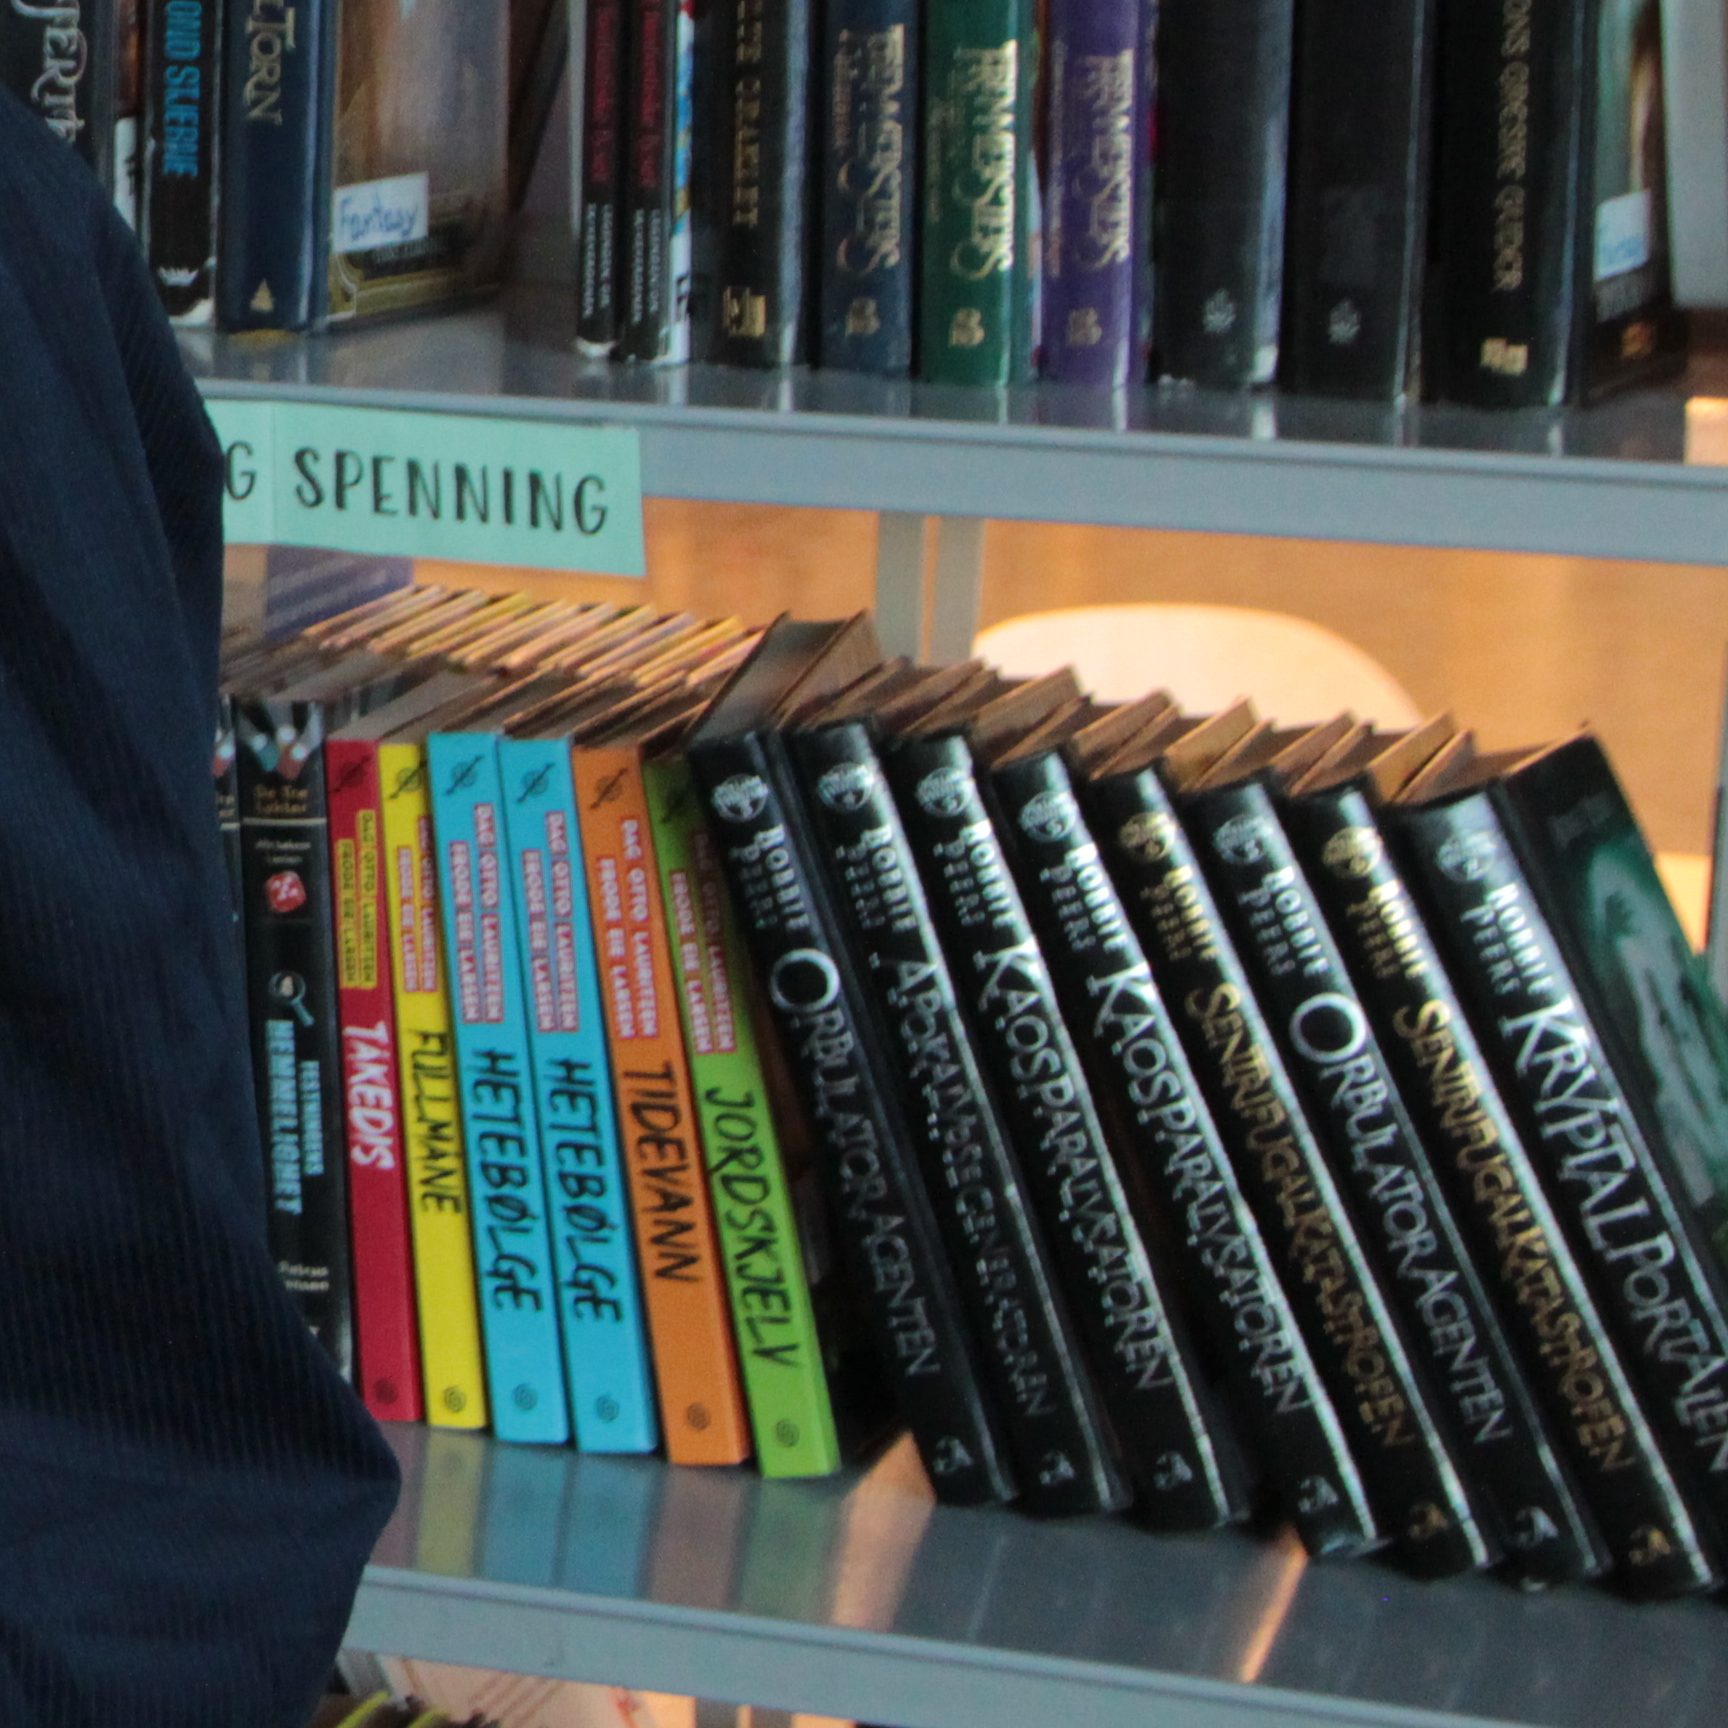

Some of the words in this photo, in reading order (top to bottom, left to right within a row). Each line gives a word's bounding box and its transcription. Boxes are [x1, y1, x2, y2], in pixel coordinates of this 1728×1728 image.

[163, 0, 203, 60] OND
[161, 64, 201, 180] STJERNE
[337, 185, 421, 242] Fantasy
[293, 445, 609, 536] SPENNING
[474, 803, 497, 844] DAG
[546, 811, 569, 854] DAG
[620, 818, 643, 860] DAG
[338, 841, 357, 895] FRODE
[396, 846, 415, 899] FRODE
[449, 842, 472, 906] FRODE
[477, 852, 502, 906] OTTO
[523, 850, 546, 914] FRODE
[550, 861, 575, 916] OTTO
[597, 855, 622, 921] FRODE
[624, 866, 650, 919] OTTO
[669, 872, 695, 936] FRODE
[340, 899, 358, 924] EIE
[398, 903, 417, 930] EIE
[453, 911, 477, 942] EIE
[527, 921, 551, 952] EIE
[602, 927, 626, 958] EIE
[341, 927, 360, 986] LARSEN
[400, 933, 420, 995] LARSEN
[421, 905, 439, 994] LAURITZEN
[457, 948, 483, 1022] LARSEN
[481, 914, 506, 1022] LAURITZEN
[554, 922, 582, 1031] LAURITZEN
[630, 928, 660, 1038] LAURITZEN
[677, 941, 702, 974] EIE
[531, 957, 558, 1031] LARSEN
[607, 964, 636, 1037] LARSEN
[682, 978, 712, 1053] LARSEN
[706, 945, 737, 1052] LAURITZEN
[342, 1020, 396, 1172] TÅKEDIS
[410, 1027, 462, 1218] FULLMÅNE
[465, 1047, 545, 1315] HETEBØLGE
[542, 1056, 626, 1326] HETEBØLGE
[621, 1060, 705, 1285] TIDEVANN
[769, 947, 941, 1377] ORBULATORAGENTEN
[974, 935, 1174, 1392] KAOSPARALYSATOREN
[1088, 960, 1314, 1418] KAOSPARALYSATOREN
[704, 1084, 806, 1372] JORDSKJELV
[1185, 981, 1416, 1451] SENTRIFUGALKATASTROFEN
[1288, 992, 1515, 1446] ORBULATORAGENTEN
[1392, 996, 1636, 1472] SENTRIFUGALKATASTROFEN
